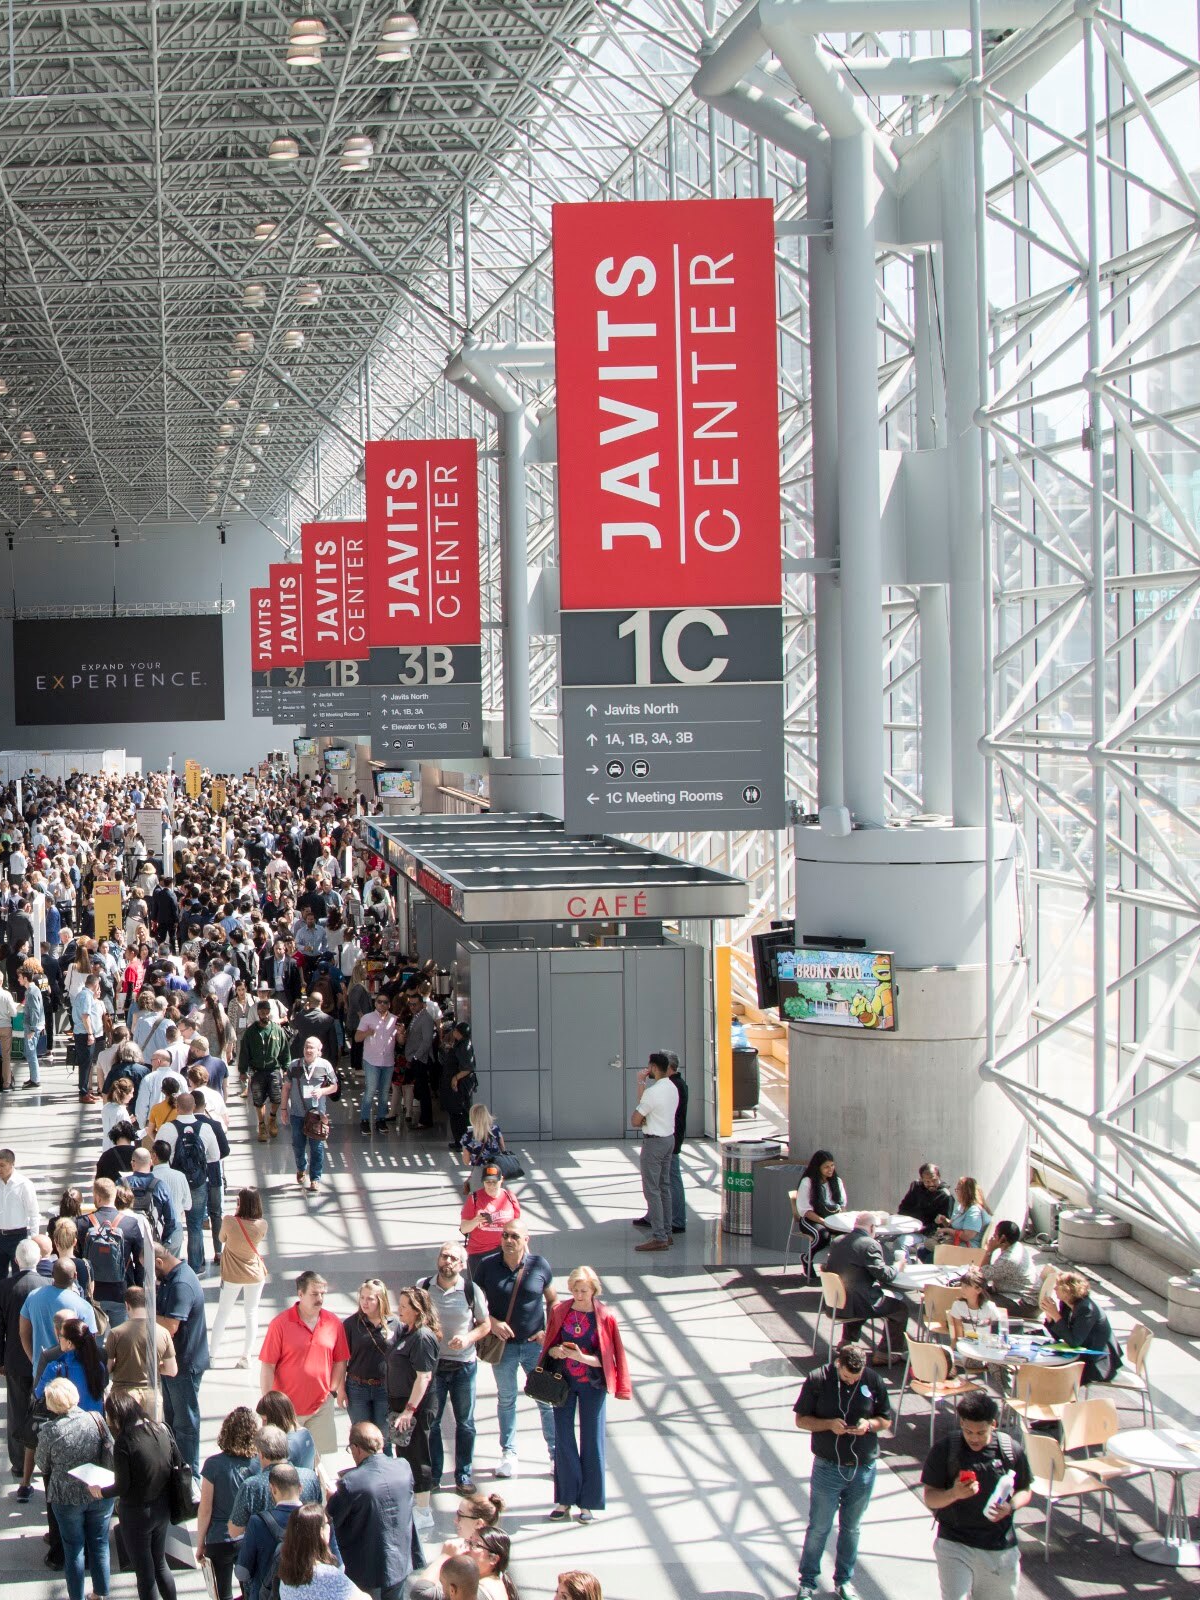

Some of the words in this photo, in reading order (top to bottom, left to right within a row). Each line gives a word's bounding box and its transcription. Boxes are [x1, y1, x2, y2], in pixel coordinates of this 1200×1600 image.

[595, 255, 662, 551] JAVITS
[689, 252, 741, 553] CENTER
[386, 468, 420, 618] JAVITS
[434, 465, 461, 618] CENTER
[280, 576, 298, 654] JAVITS
[315, 540, 339, 642] JAVITS
[347, 539, 366, 642] CENTER
[259, 598, 272, 660] JAVITS
[618, 608, 729, 685] 1C
[36, 671, 207, 690] EXPERIENCE.
[81, 663, 124, 671] EXPAND
[130, 662, 161, 670] YOUR
[325, 660, 360, 688] 1B
[398, 645, 456, 687] 3B
[604, 704, 640, 716] Javits
[644, 702, 679, 714] North
[605, 733, 625, 746] 1A,
[628, 733, 648, 745] 1B,
[651, 732, 672, 744] 3A,
[676, 731, 693, 743] 3B
[606, 792, 623, 804] 1C
[626, 791, 676, 805] Meeting
[679, 790, 724, 802] Rooms
[567, 891, 647, 917] CAFÉ
[796, 963, 833, 979] BRONX
[837, 963, 862, 980] ZOO
